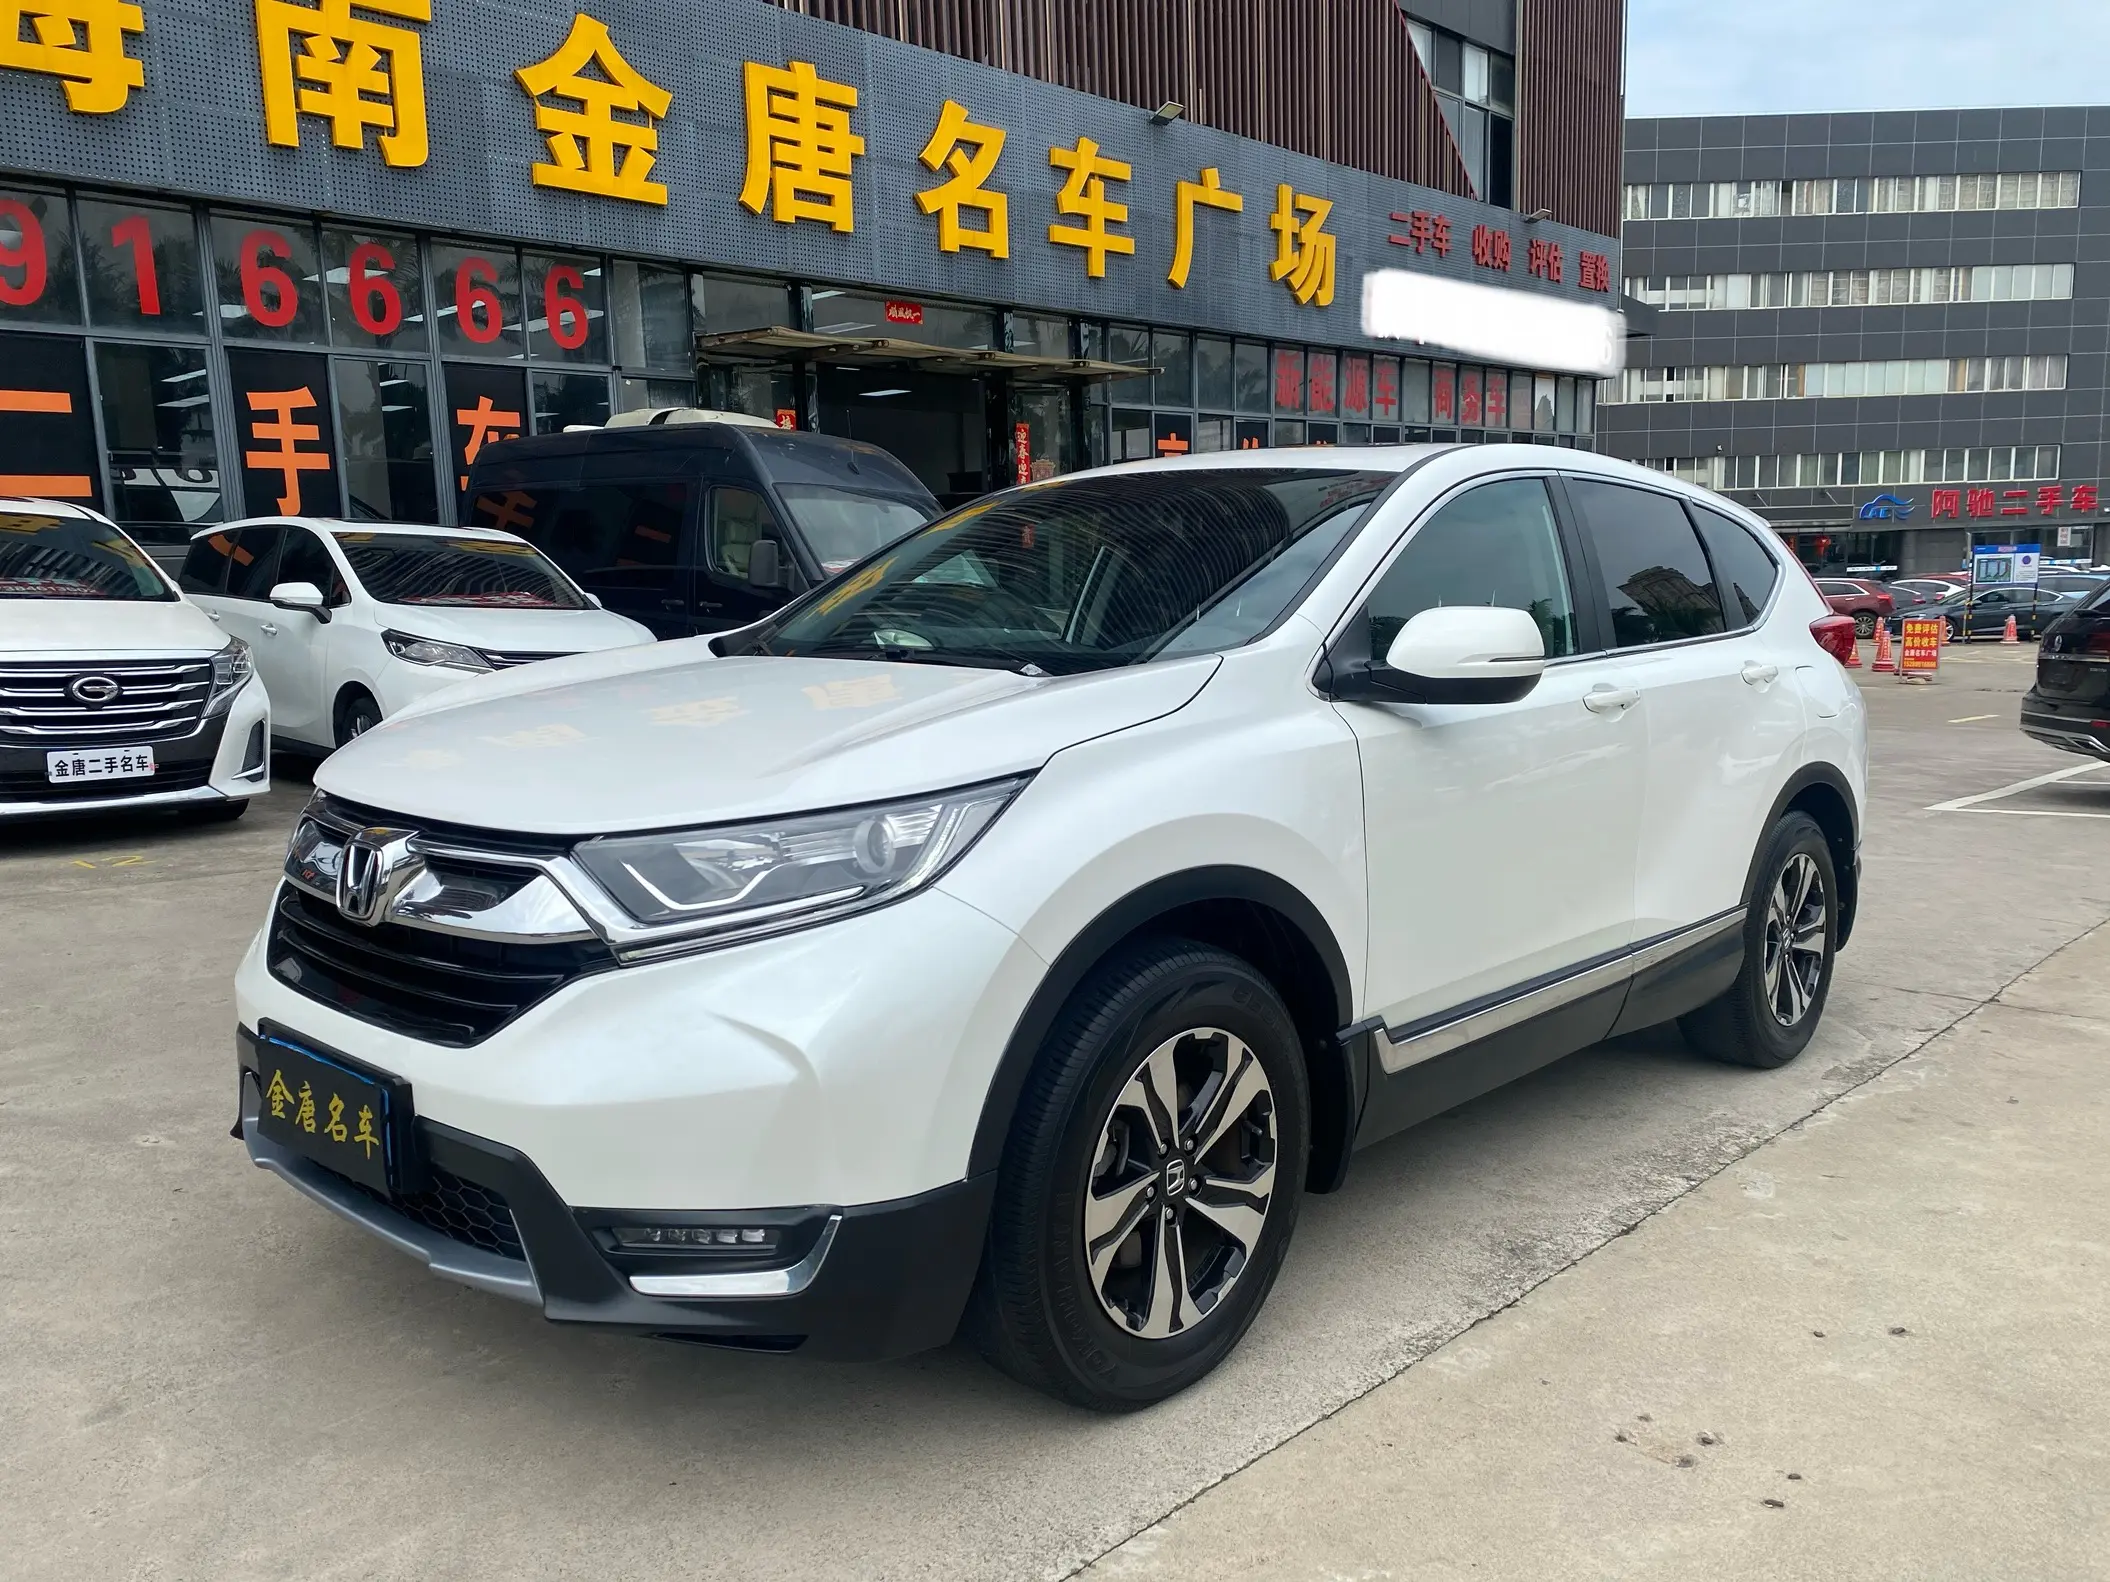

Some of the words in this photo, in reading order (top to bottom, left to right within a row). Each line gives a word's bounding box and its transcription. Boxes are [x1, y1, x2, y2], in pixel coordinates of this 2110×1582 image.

[1388, 211, 1450, 257] 二手车
[1472, 224, 1511, 272] 收购
[1528, 239, 1563, 283] 评估
[1579, 250, 1610, 292] 置换
[1276, 352, 1397, 416] 新能源车
[1434, 367, 1506, 426] 商务车
[1931, 485, 2099, 519] 阿驰二手车
[1905, 636, 1938, 648] 高价收车
[1906, 623, 1939, 634] 免费评估
[54, 754, 150, 777] 金唐二手名车
[266, 1069, 380, 1160] 金唐名车
